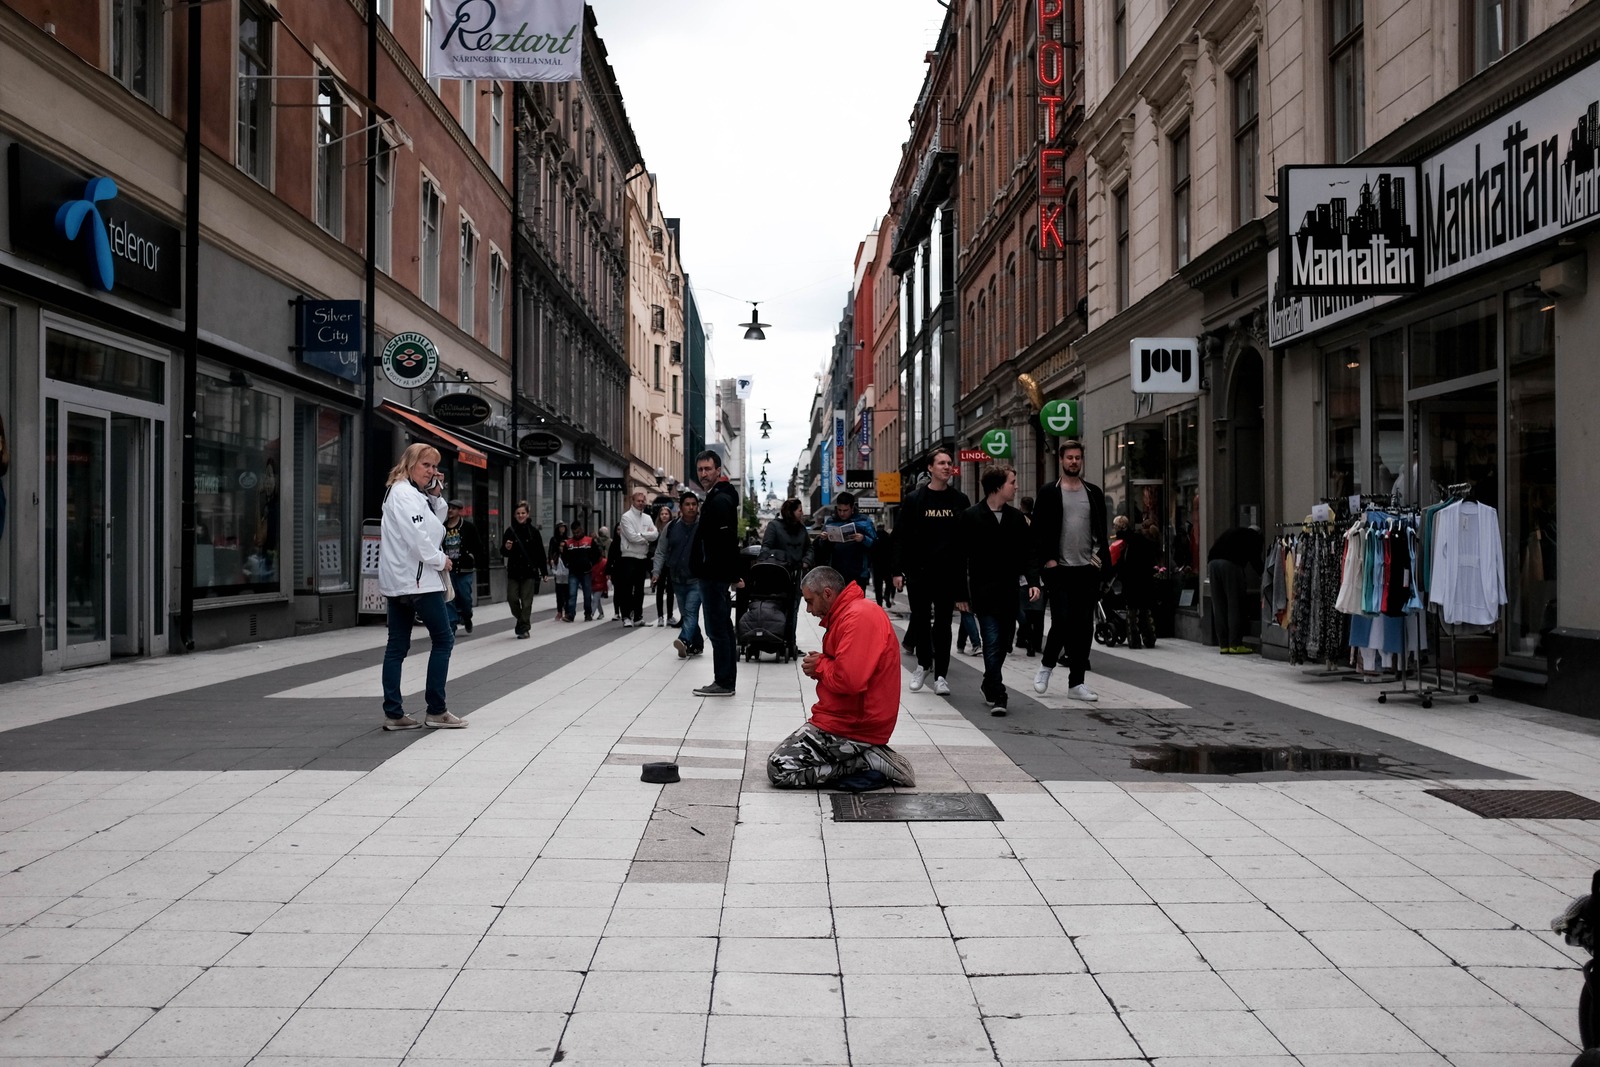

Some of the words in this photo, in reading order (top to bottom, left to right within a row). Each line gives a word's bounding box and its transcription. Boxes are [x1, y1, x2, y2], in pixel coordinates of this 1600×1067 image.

[440, 0, 578, 54] Reztart
[452, 54, 508, 64] NÄRINGSRIKT
[509, 56, 563, 66] MELLANMÅL
[1425, 120, 1559, 275] Manhattan
[108, 219, 161, 273] telenor
[1291, 234, 1415, 286] Manhattan
[312, 307, 353, 324] Silver
[317, 326, 349, 345] City
[384, 334, 436, 365] SUSHIRULLEN
[836, 417, 844, 475] INTERSPORT
[847, 481, 873, 489] SCORETT
